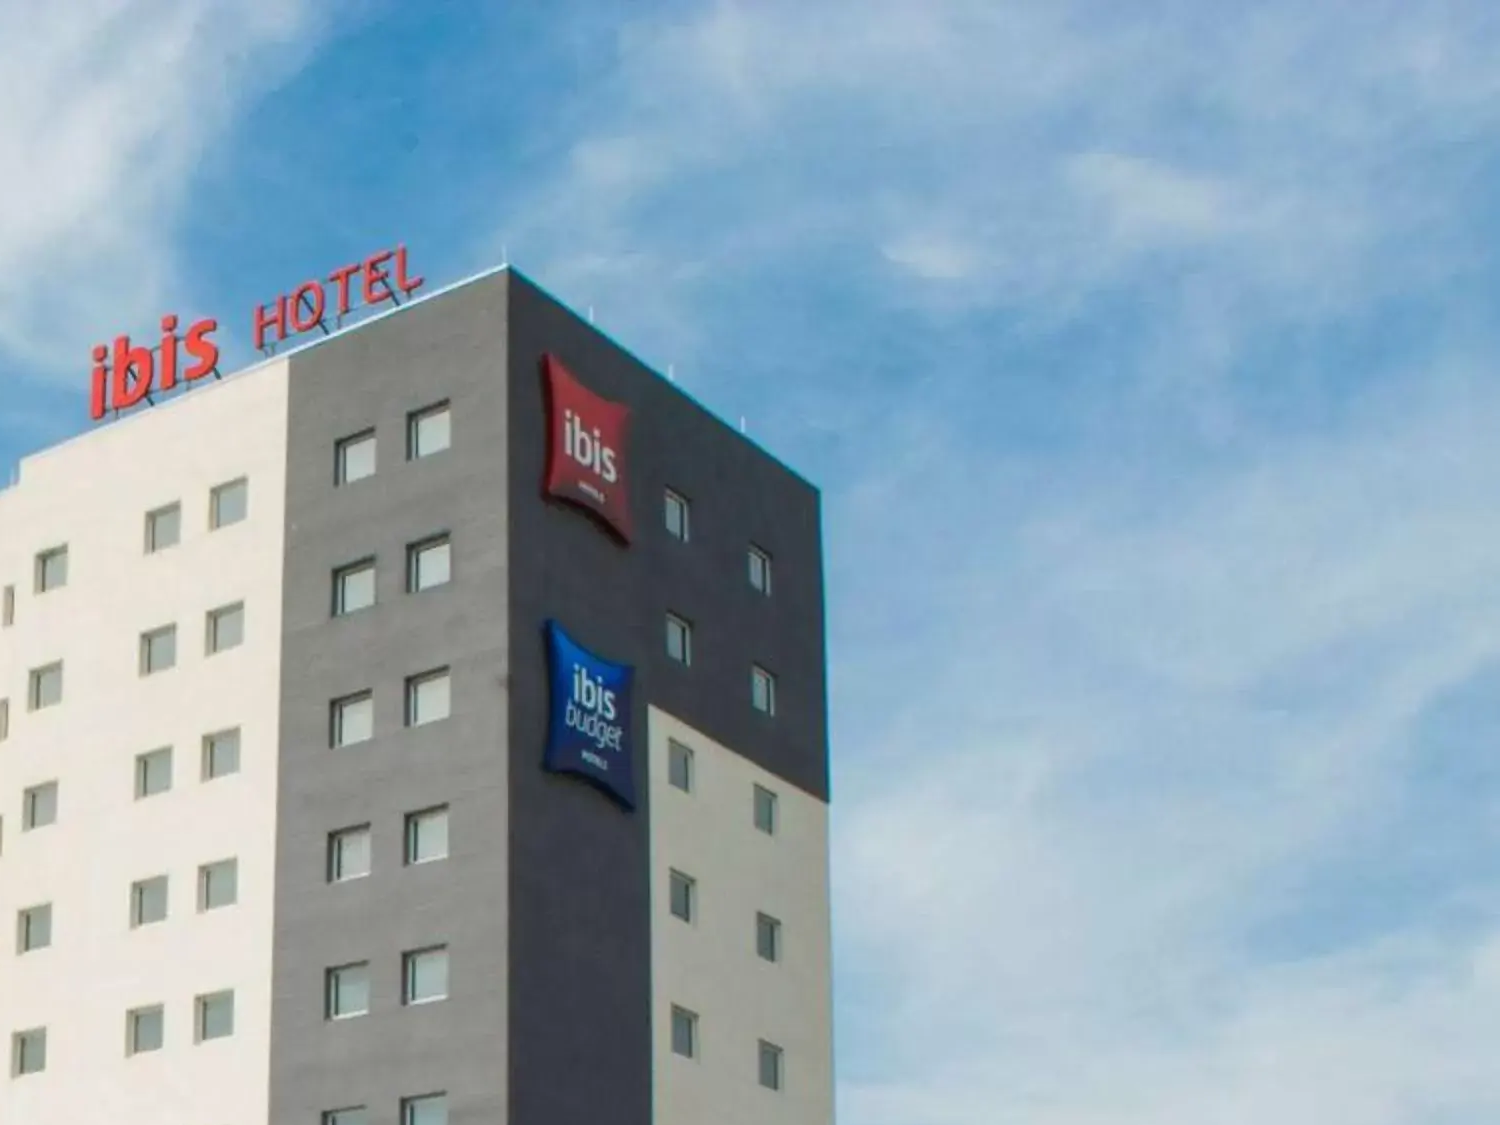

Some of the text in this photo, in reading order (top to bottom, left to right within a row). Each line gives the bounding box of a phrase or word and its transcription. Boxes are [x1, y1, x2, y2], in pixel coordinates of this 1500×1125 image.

[89, 243, 424, 419] ibis HOTEL
[564, 408, 618, 484] ibis
[573, 662, 616, 721] ibis
[565, 699, 623, 752] budget
